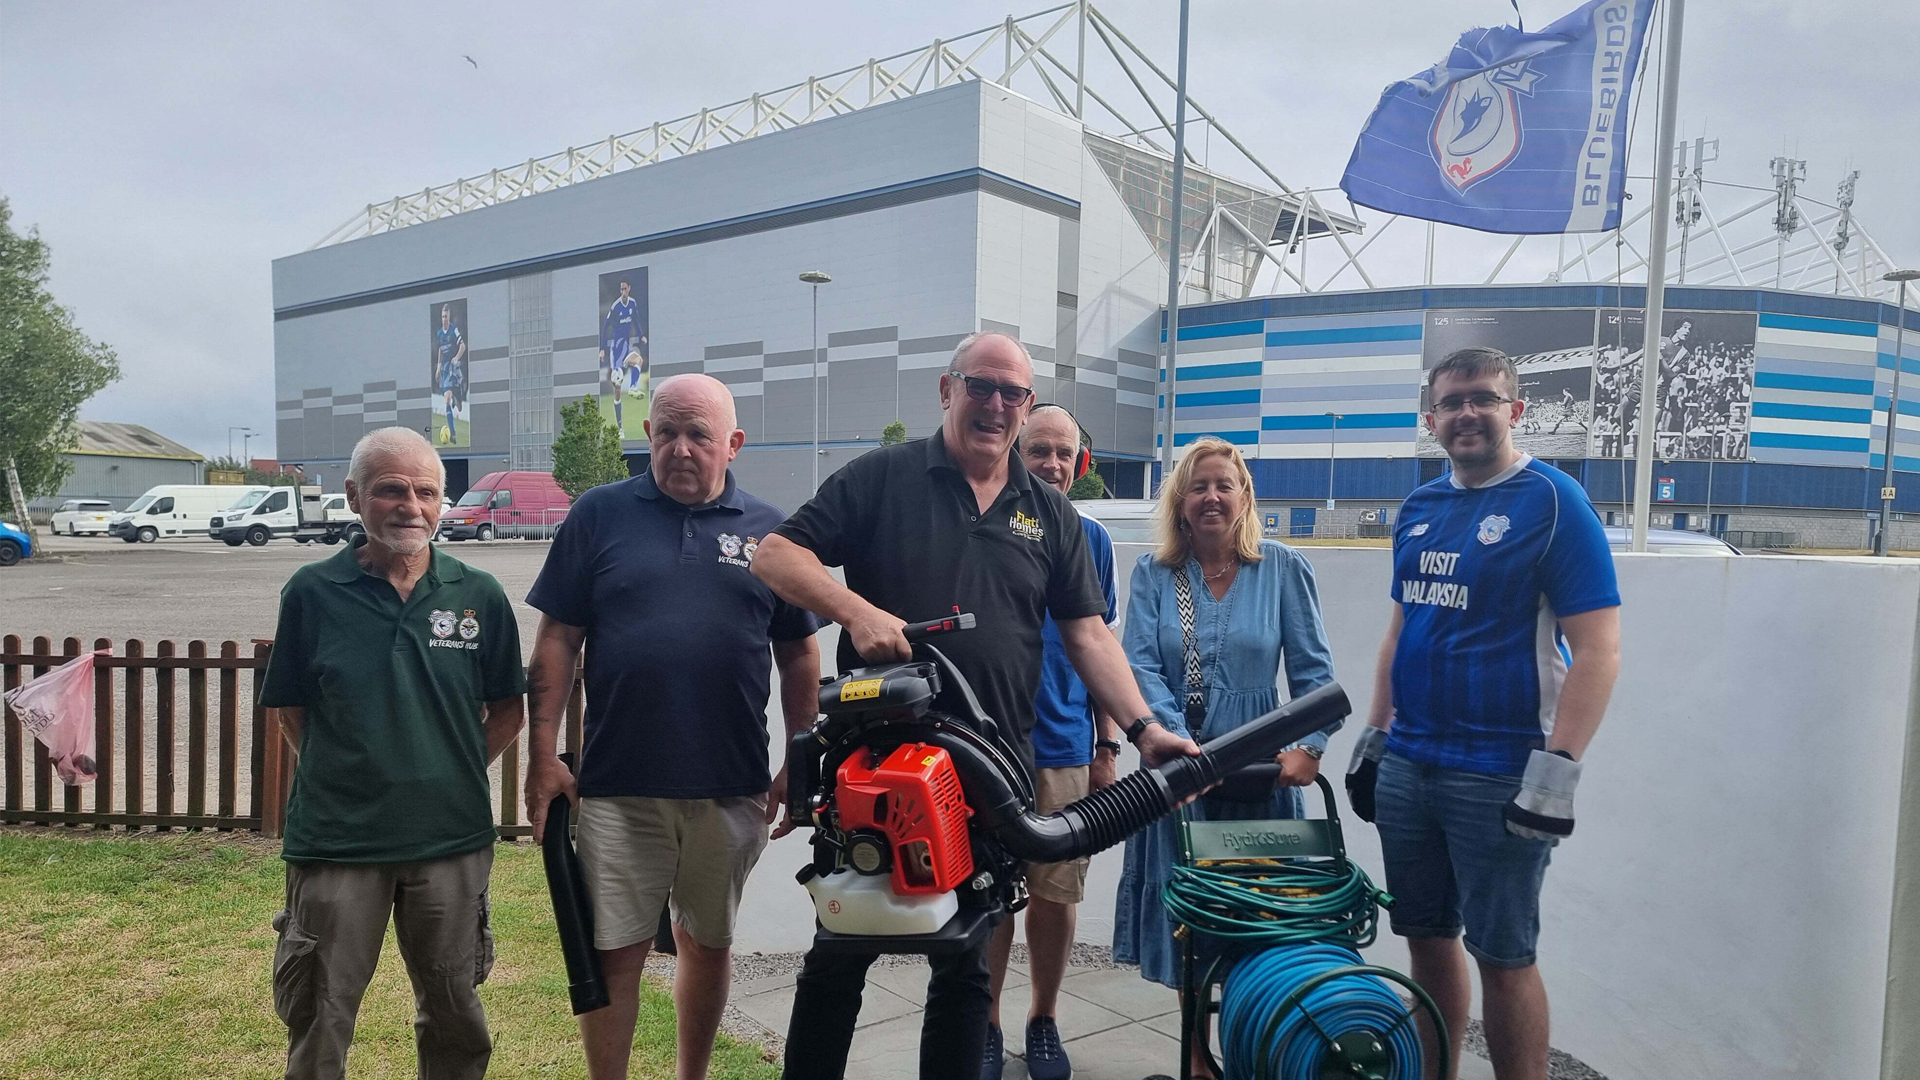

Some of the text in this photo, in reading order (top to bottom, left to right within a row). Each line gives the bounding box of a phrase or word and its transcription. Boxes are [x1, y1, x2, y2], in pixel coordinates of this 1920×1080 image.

[1434, 317, 1449, 326] 125
[1662, 486, 1671, 499] 5
[1009, 516, 1044, 536] Homes
[718, 555, 749, 567] VETERANS
[1419, 550, 1461, 577] VISIT
[428, 638, 465, 649] VETERANS
[1222, 830, 1301, 851] HydroSure
